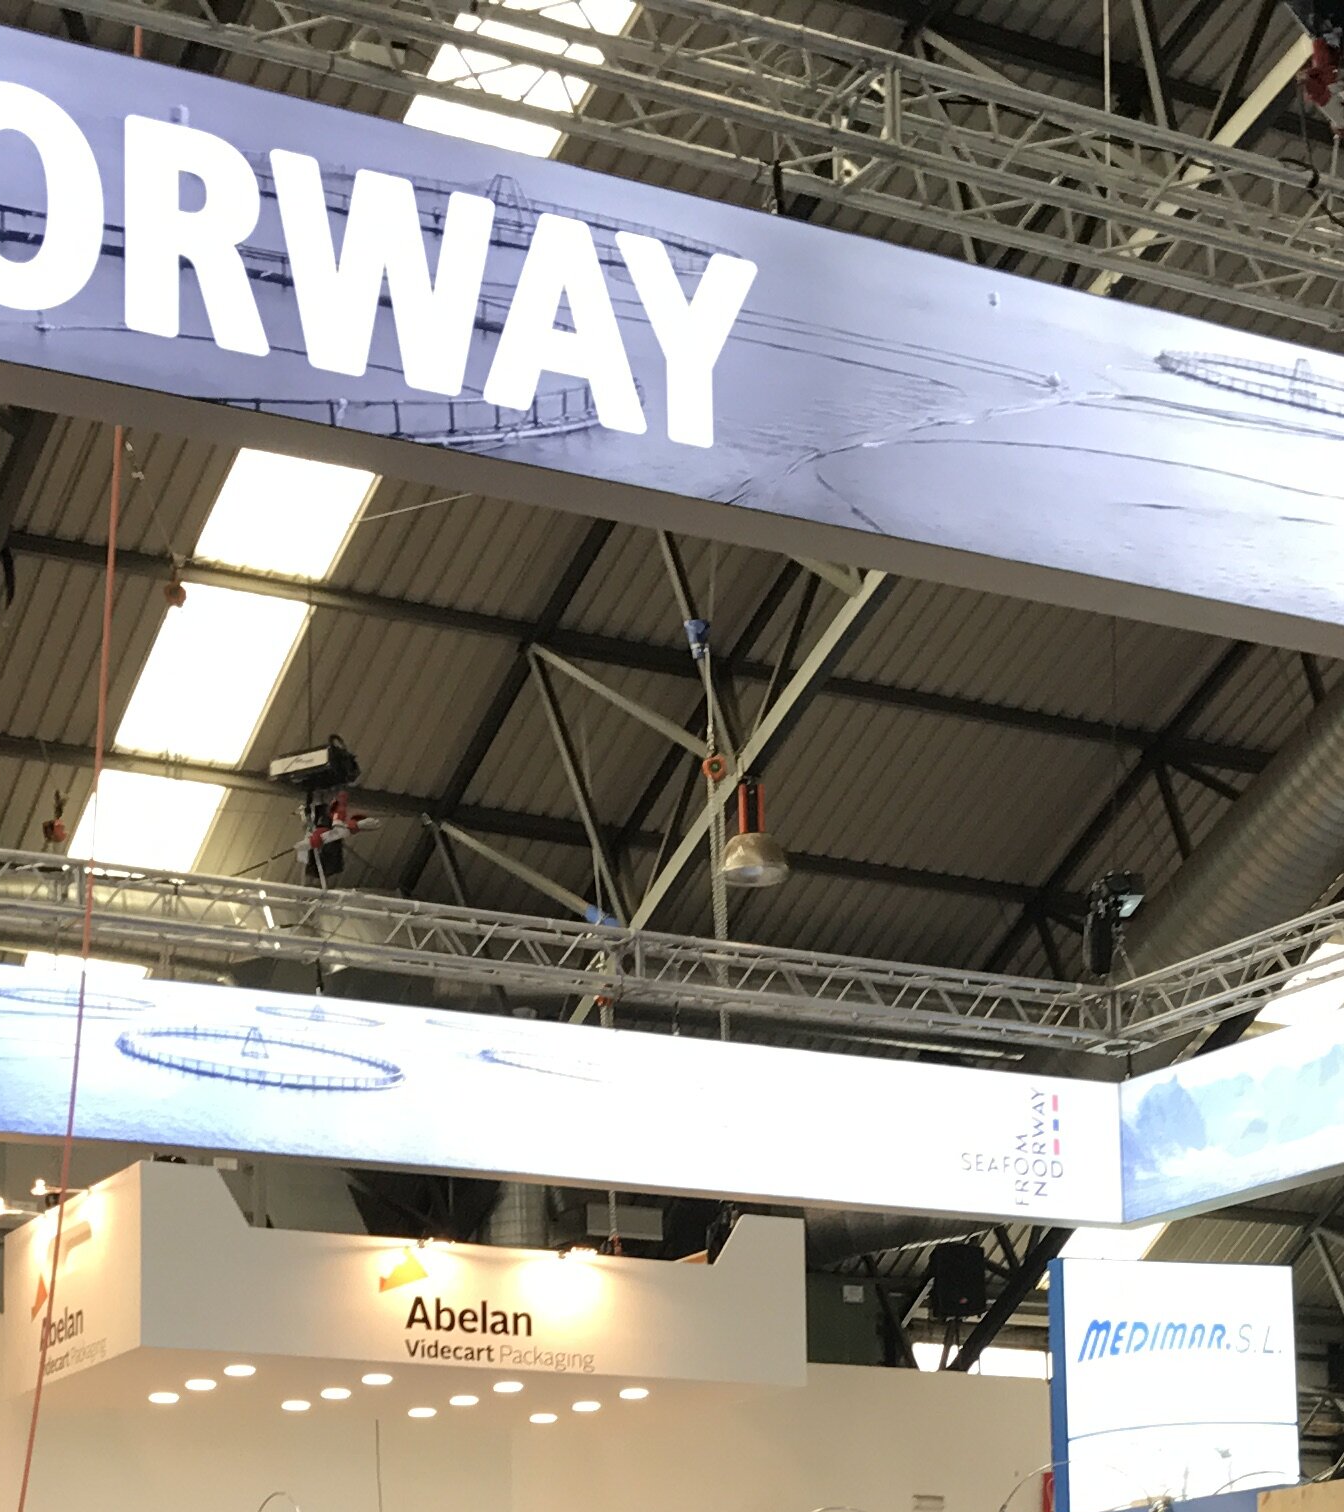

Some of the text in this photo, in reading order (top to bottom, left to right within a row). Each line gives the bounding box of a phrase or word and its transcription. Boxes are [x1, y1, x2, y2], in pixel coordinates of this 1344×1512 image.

[961, 1152, 1064, 1179] SEAFOOD
[405, 1296, 533, 1337] Abelan
[405, 1338, 596, 1373] Videcart Packaging
